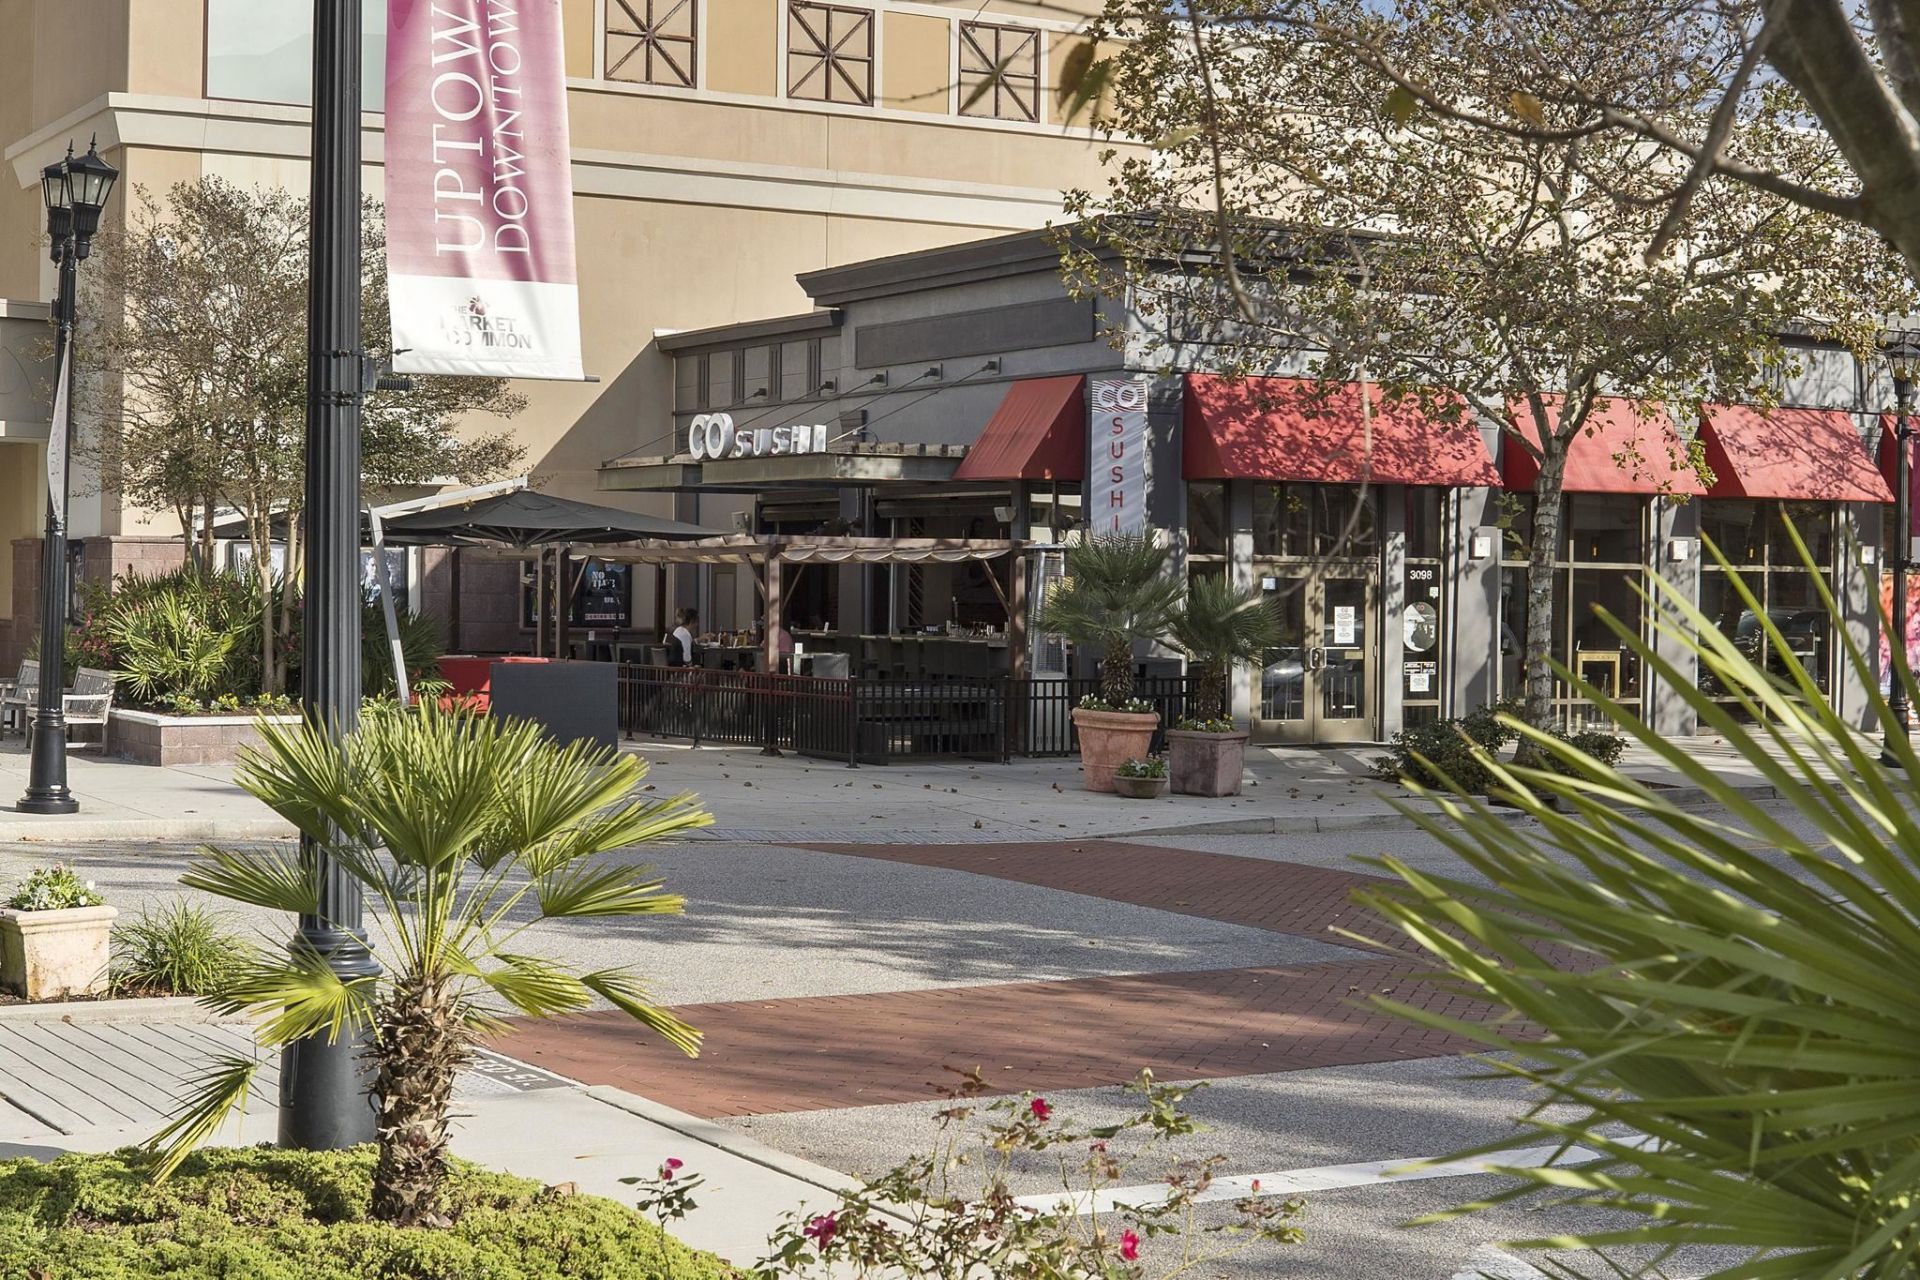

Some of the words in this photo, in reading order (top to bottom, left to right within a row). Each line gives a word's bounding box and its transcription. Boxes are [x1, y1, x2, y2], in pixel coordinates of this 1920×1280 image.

[431, 0, 486, 257] UPTOW
[452, 305, 468, 315] HE
[440, 314, 517, 332] ARKET
[1097, 384, 1139, 408] CO
[689, 413, 734, 460] CO
[735, 425, 827, 458] SUSHI
[1110, 417, 1125, 532] SUSHI
[1410, 570, 1433, 580] 3098
